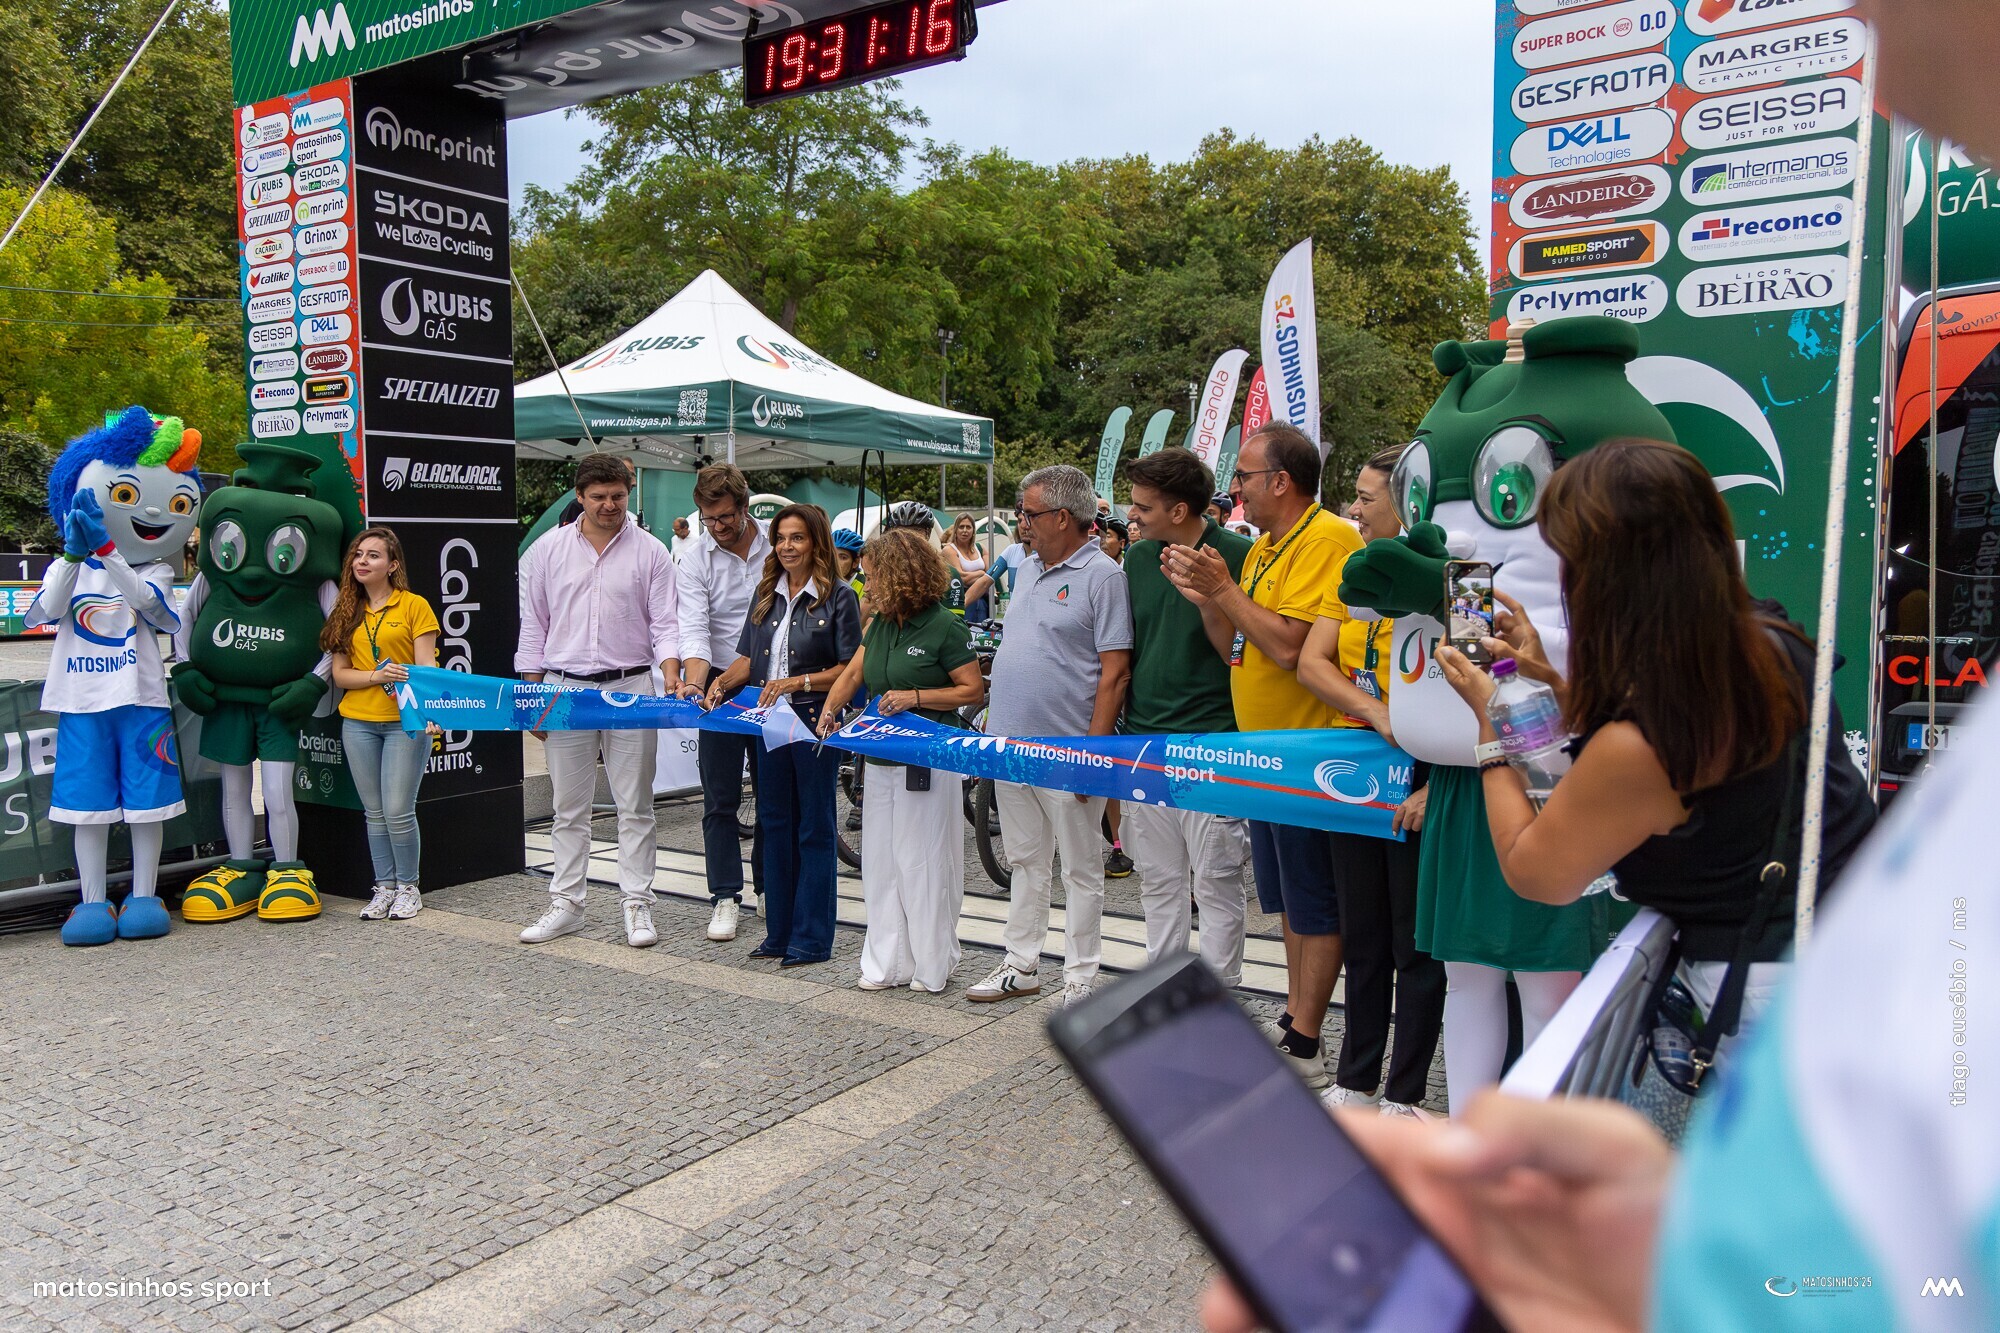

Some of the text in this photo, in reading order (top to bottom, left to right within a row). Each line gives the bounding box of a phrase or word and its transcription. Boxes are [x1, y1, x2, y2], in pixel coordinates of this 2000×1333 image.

[365, 0, 474, 43] matosinhos
[1520, 10, 1666, 53] SUPER BOCK 0.0
[1699, 28, 1848, 68] MARGRES
[1699, 54, 1848, 85] CERAMIC TILES
[1518, 63, 1667, 109] GESFROTA
[314, 112, 342, 124] matosinhos
[1699, 87, 1846, 131] SEISSA
[1548, 116, 1631, 152] DELL
[1725, 120, 1816, 142] JUST FOR YOU
[296, 132, 342, 150] matosinhos
[404, 127, 496, 168] mr.print
[296, 149, 317, 163] sport
[1548, 147, 1631, 169] Technologies
[1728, 151, 1848, 181] Intermanos
[300, 184, 308, 192] We
[321, 178, 340, 189] Cycling
[1728, 178, 1768, 190] comércio
[1532, 181, 1645, 211] LANDEIRO
[310, 198, 344, 215] mr.print
[248, 209, 290, 229] SPECIALIZED
[1732, 211, 1843, 237] reconco
[375, 221, 401, 241] We
[442, 236, 494, 262] Cycling
[1729, 239, 1739, 248] de
[1793, 228, 1843, 240] transportes
[1551, 252, 1608, 265] SUPERFOOD
[260, 271, 290, 285] catlike
[299, 268, 314, 277] SUPER
[314, 265, 328, 274] BOCK
[1735, 267, 1792, 280] LICOR
[1519, 282, 1648, 313] Polymark
[1696, 269, 1833, 308] BEIRÃO
[251, 297, 291, 311] MARGRES
[300, 289, 349, 308] GESFROTA
[1603, 306, 1648, 320] Group
[311, 316, 339, 333] DELL
[424, 317, 457, 341] GÁS
[253, 326, 293, 343] SEISSA
[262, 357, 295, 369] Intermanos
[307, 352, 345, 365] LANDEIRO
[265, 387, 295, 398] reconco
[379, 377, 500, 410] SPECIALIZED
[306, 408, 349, 423] Polymark
[591, 415, 672, 429] www.rubisgas.pt
[770, 415, 787, 430] GÁS
[257, 417, 295, 433] BEIRÃO
[906, 437, 961, 453] www.rubisgas.pt
[411, 462, 500, 485] BLACKJACK
[427, 483, 475, 491] PERFORMANCE
[19, 559, 28, 580] 1
[234, 636, 258, 651] GÁS
[424, 697, 486, 709] matosinhos
[515, 696, 546, 710] sport
[1014, 742, 1113, 769] matosinhos
[1165, 743, 1283, 771] matosinhos
[1164, 763, 1215, 784] sport
